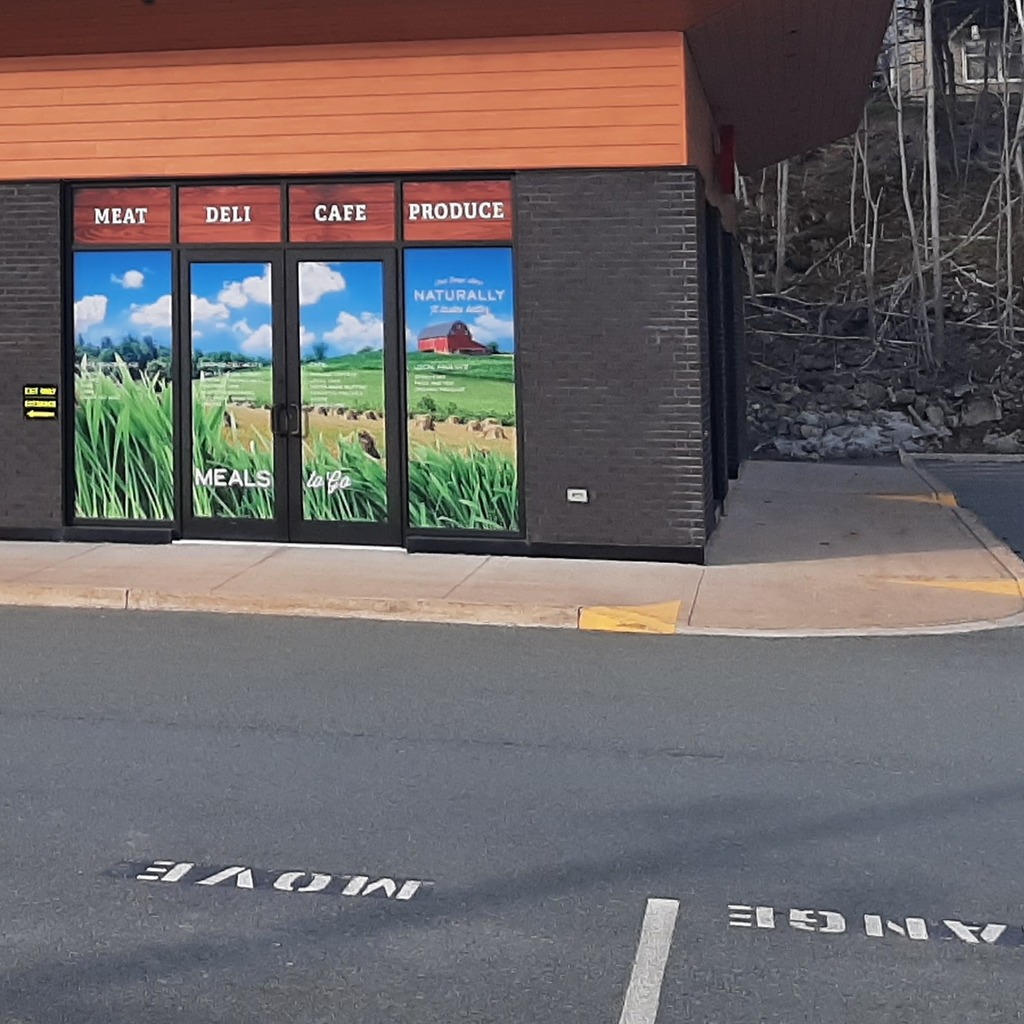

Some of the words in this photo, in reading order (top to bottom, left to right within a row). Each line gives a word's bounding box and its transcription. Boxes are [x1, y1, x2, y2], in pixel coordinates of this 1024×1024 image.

[94, 207, 148, 225] MEAT
[205, 205, 251, 223] DELI
[314, 204, 367, 222] CAFE
[408, 201, 505, 221] PRODUCE
[414, 289, 506, 301] NATURALLY
[195, 468, 271, 488] MEALS
[136, 861, 426, 901] MOVE
